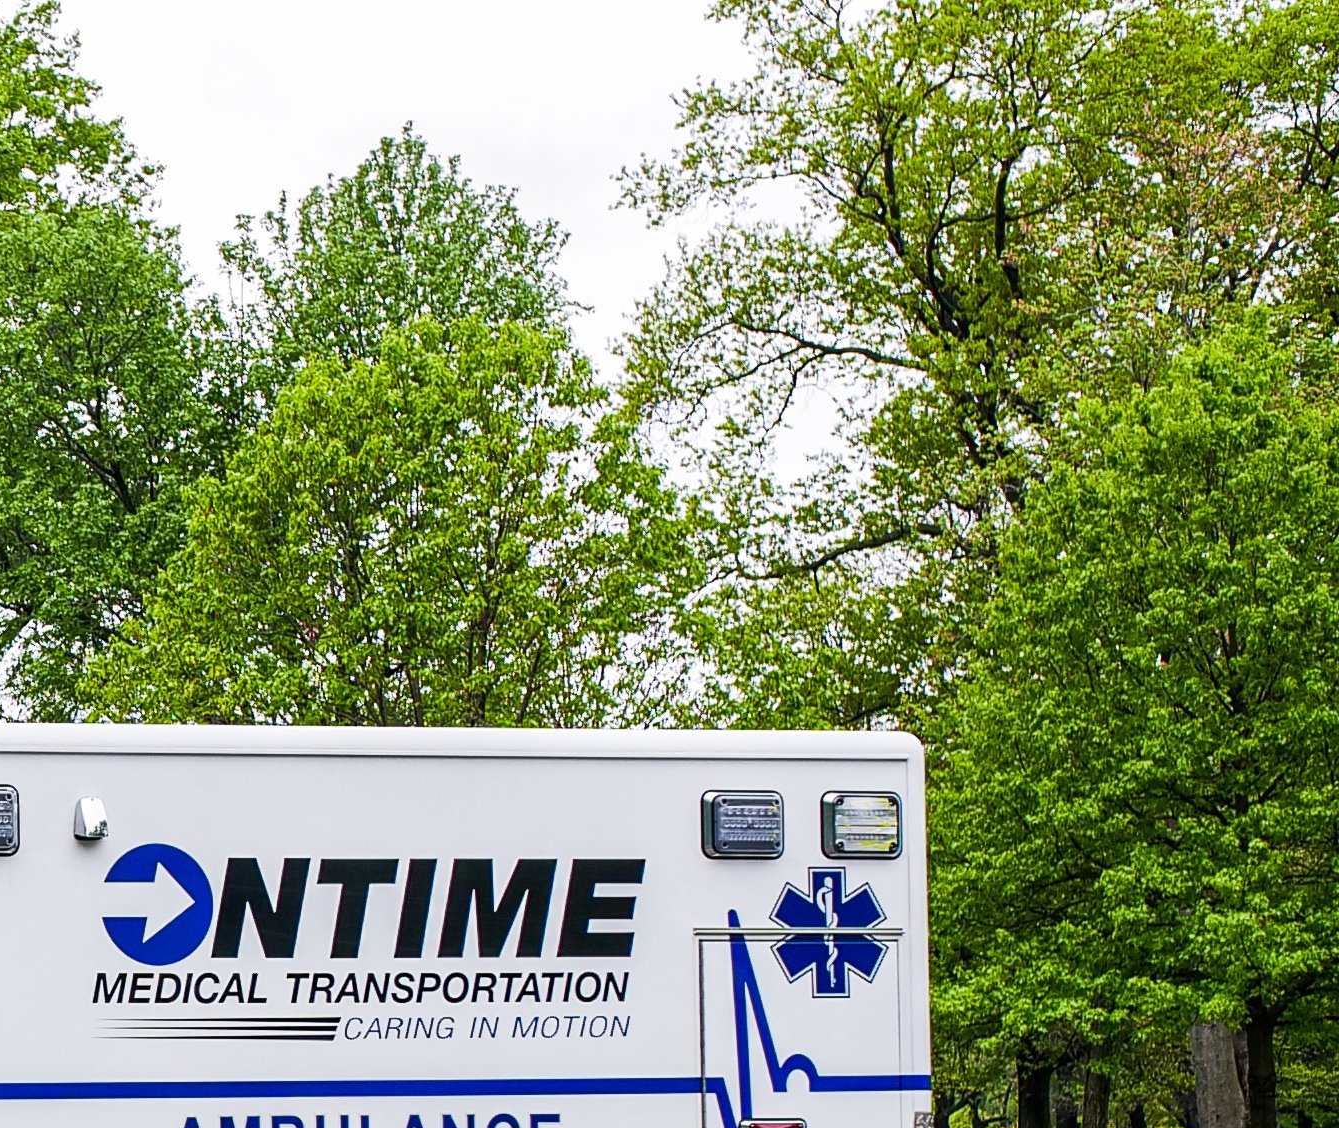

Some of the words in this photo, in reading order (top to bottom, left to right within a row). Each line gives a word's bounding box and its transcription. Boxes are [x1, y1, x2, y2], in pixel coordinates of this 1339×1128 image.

[92, 972, 268, 1005] MEDICAL
[285, 971, 630, 1004] TRANSPORTATION
[343, 1016, 456, 1041] CARING
[469, 1016, 500, 1039] IN
[511, 1015, 631, 1039] MOTION
